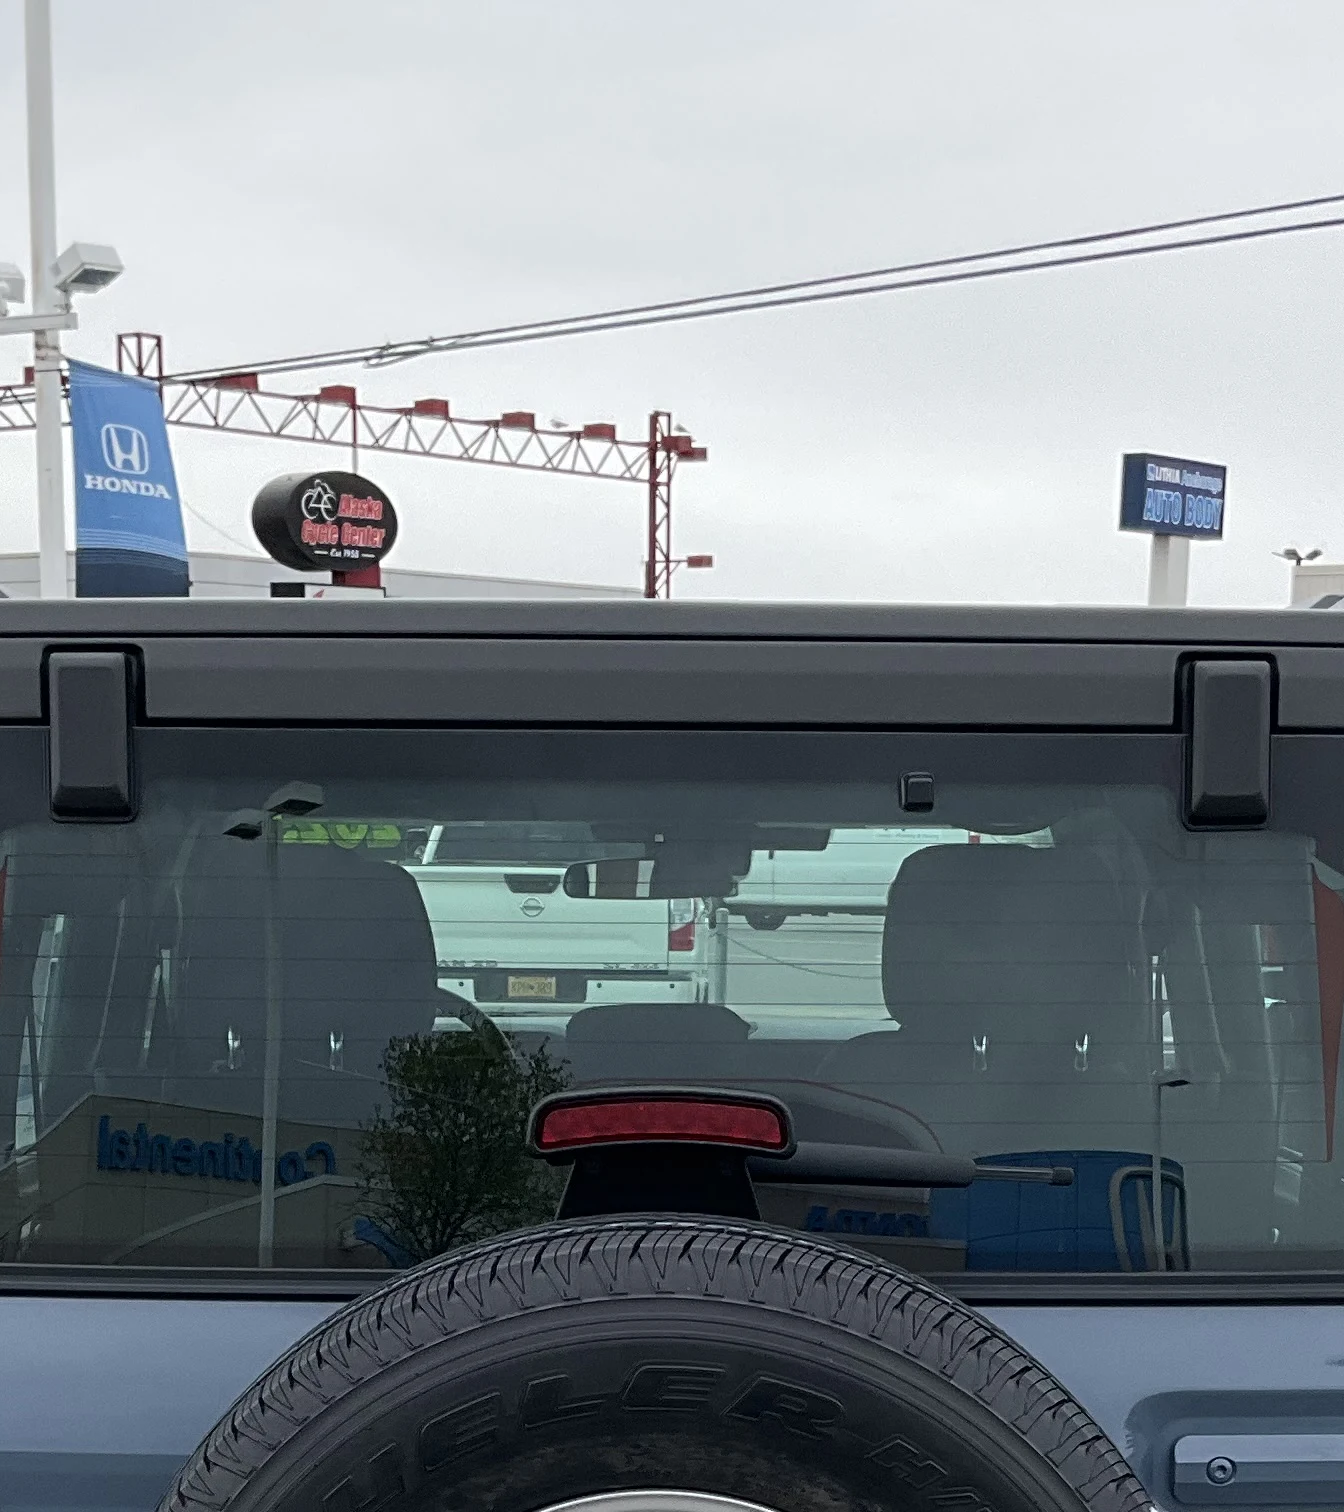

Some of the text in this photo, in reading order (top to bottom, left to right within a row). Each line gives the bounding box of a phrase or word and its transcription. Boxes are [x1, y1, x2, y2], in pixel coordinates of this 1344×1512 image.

[83, 473, 172, 500] HONDA
[337, 493, 383, 521] Alaska
[1142, 487, 1224, 531] AUTO BODY
[300, 519, 386, 549] Cycle Center
